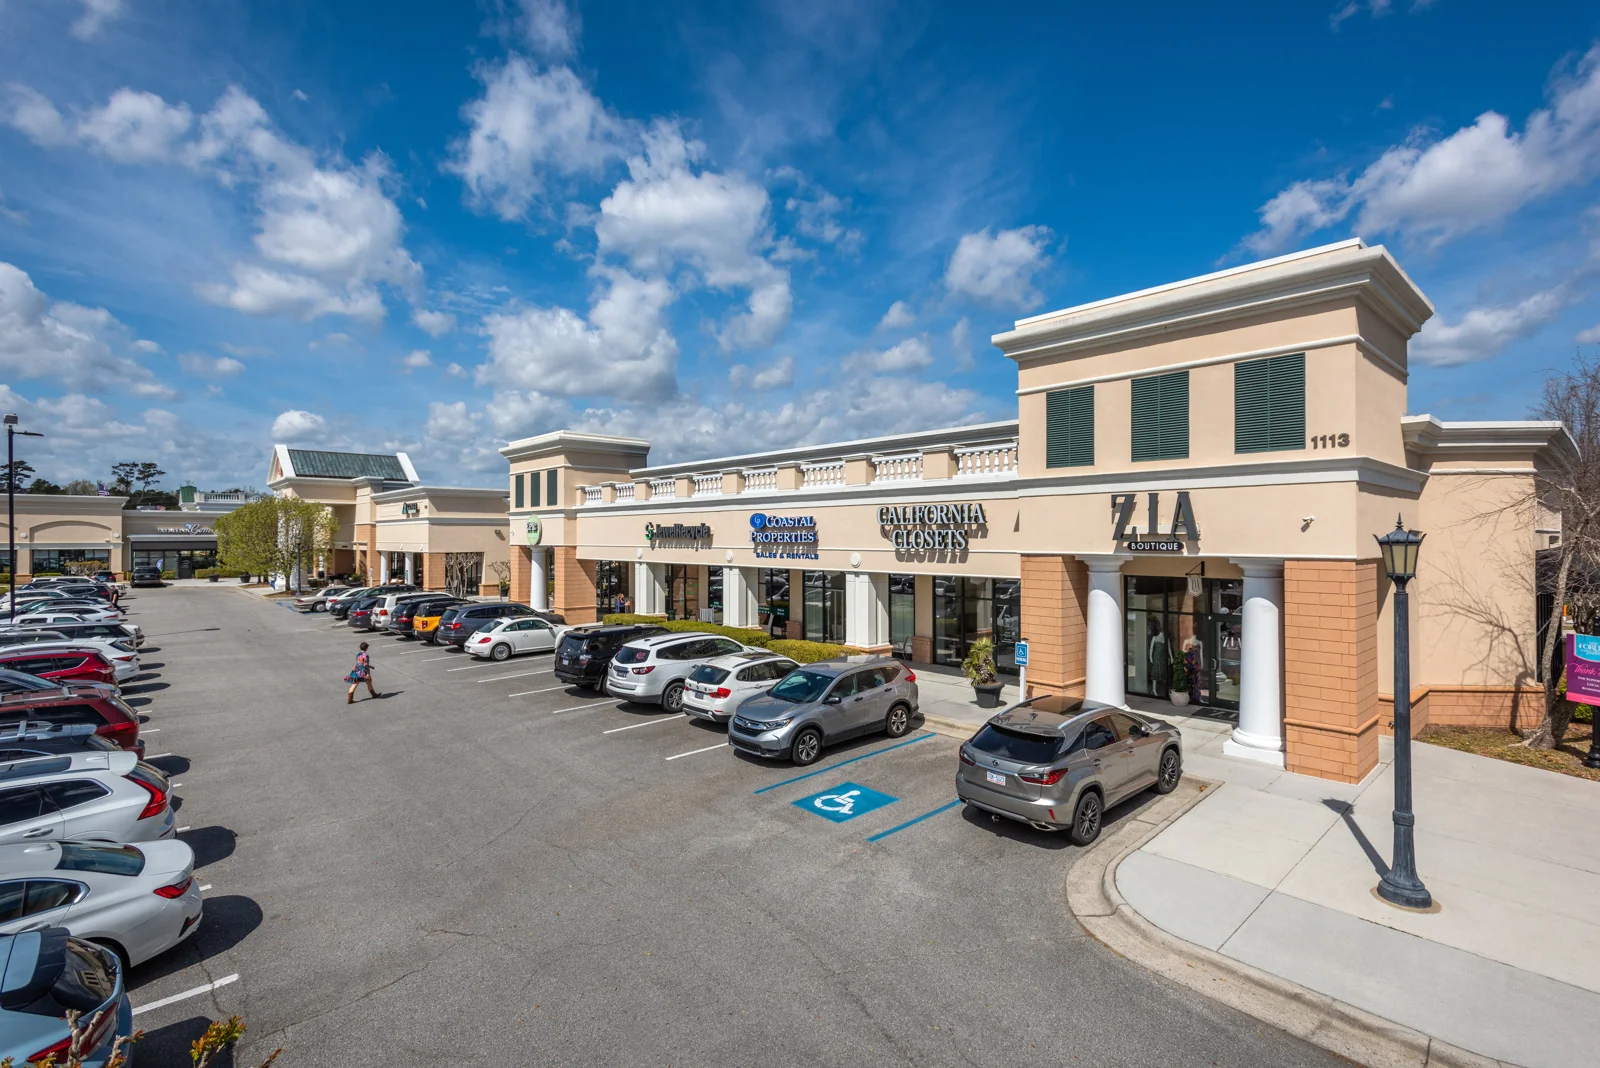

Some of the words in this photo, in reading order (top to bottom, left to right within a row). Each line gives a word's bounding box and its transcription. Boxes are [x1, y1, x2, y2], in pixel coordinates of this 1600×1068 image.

[1311, 433, 1350, 450] 1113
[765, 515, 816, 528] COASTAL
[877, 503, 987, 525] CALIFORNIA
[1111, 491, 1201, 541] ZIA
[654, 523, 711, 540] JewelRecycle
[749, 530, 817, 543] PROPERTIES
[892, 529, 968, 550] CLOSETS
[1131, 542, 1179, 551] BOUTIQUE
[786, 552, 819, 560] RENTALS
[1569, 663, 1597, 676] Thank
